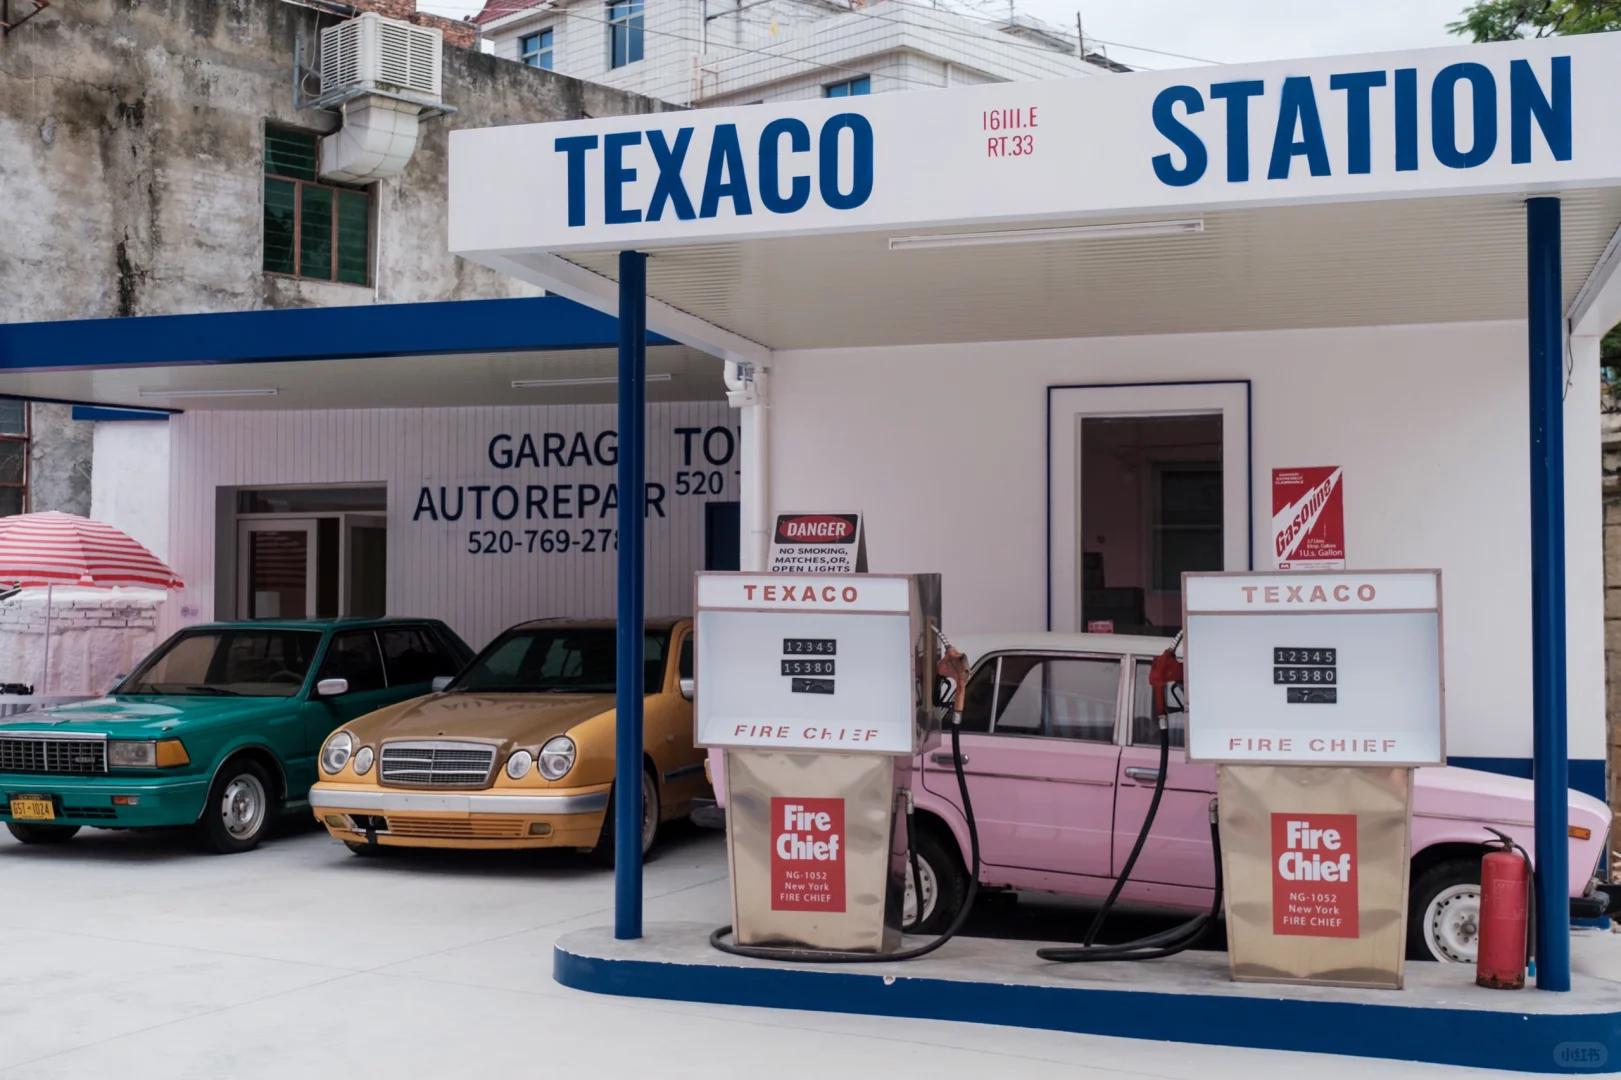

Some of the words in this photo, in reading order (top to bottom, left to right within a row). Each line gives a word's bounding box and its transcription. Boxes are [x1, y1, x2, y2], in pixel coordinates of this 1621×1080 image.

[555, 113, 874, 227] TEXACO
[1152, 55, 1572, 187] STATION
[988, 134, 1033, 157] RT.33
[488, 430, 618, 469] GARAG
[674, 426, 741, 466] TO
[675, 470, 723, 495] 520
[412, 482, 666, 521] AUTOREPAR
[1275, 478, 1331, 557] Gasoline
[787, 522, 846, 537] DANGER
[798, 548, 848, 556] SMOKING,
[1318, 549, 1343, 557] Gallon
[743, 585, 858, 603] TEXACO
[1241, 584, 1376, 603] TEXACO
[786, 641, 834, 652] 12345
[1277, 651, 1333, 662] 12345
[784, 662, 832, 673] 15380
[1277, 670, 1334, 681] 15380
[734, 725, 790, 738] FIRE
[1229, 738, 1292, 751] FIRE
[1309, 738, 1396, 752] CHIEF
[784, 804, 832, 831] Fire
[1287, 821, 1342, 850] Fire
[776, 833, 839, 861] Chief
[1278, 851, 1351, 882] Chief
[786, 871, 827, 880] NG-1052
[784, 882, 805, 890] New
[808, 882, 829, 891] York
[780, 893, 800, 901] FIRE
[803, 893, 832, 902] CHIEF
[1290, 893, 1337, 902] NG-1052
[1288, 904, 1312, 913] New
[1316, 905, 1340, 915] York
[1283, 916, 1306, 925] FIRE
[1310, 917, 1342, 927] CHIEF
